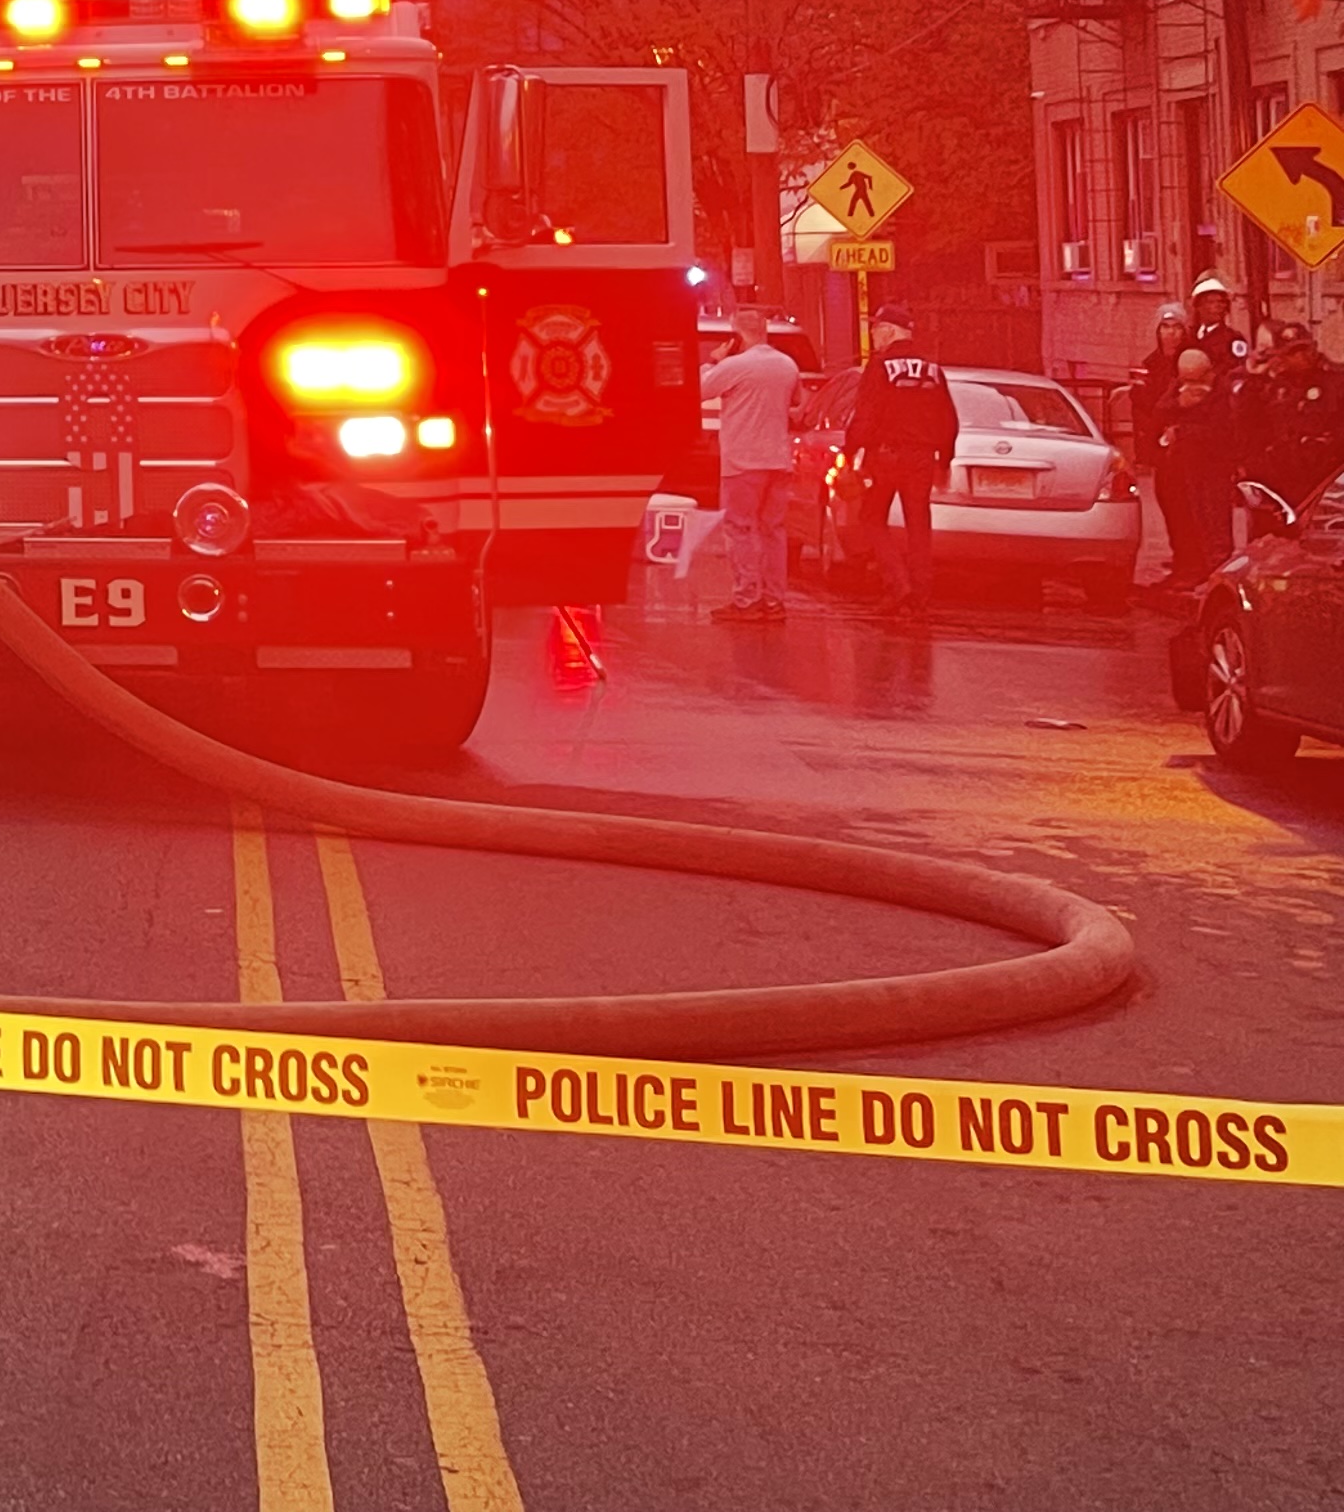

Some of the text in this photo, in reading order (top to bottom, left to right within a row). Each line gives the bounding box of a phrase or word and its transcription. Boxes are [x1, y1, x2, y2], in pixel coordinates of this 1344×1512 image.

[23, 88, 72, 103] THE
[105, 85, 156, 101] 4TH
[163, 83, 305, 100] BATTALION
[123, 281, 196, 315] CITY
[60, 577, 146, 628] E9
[24, 1032, 80, 1082] DO
[103, 1037, 191, 1090] NOT
[214, 1046, 368, 1105] CROSS
[517, 1067, 1288, 1172] POLICE LINE DO NOT CROSS
